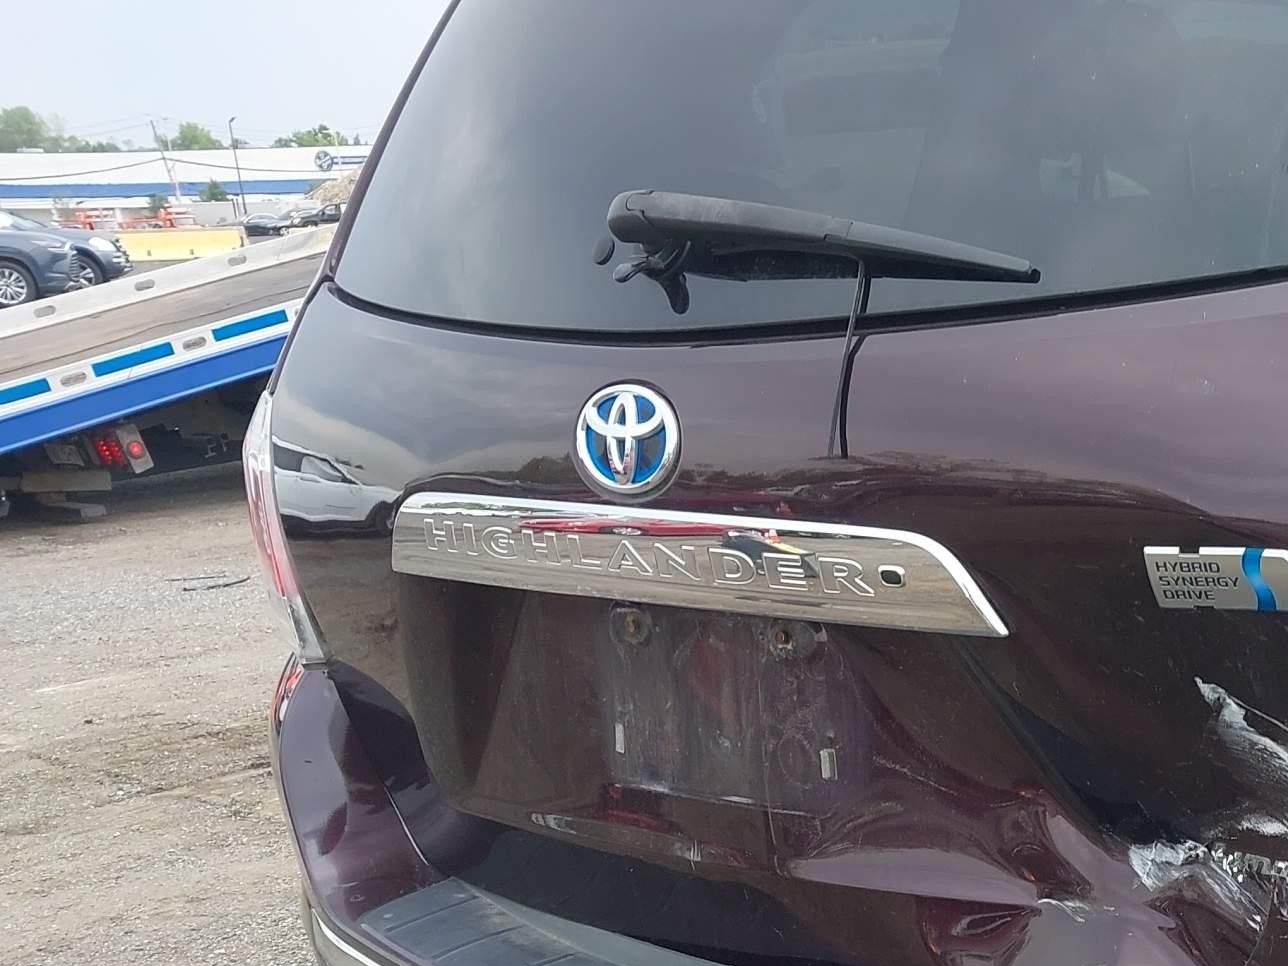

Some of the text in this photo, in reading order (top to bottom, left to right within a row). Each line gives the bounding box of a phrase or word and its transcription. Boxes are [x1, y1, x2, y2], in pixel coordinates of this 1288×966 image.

[423, 518, 875, 597] HIGHLANDER
[1155, 561, 1221, 573] HYBRID
[1158, 576, 1239, 588] SYNERGY
[1163, 590, 1216, 601] DRIVE
